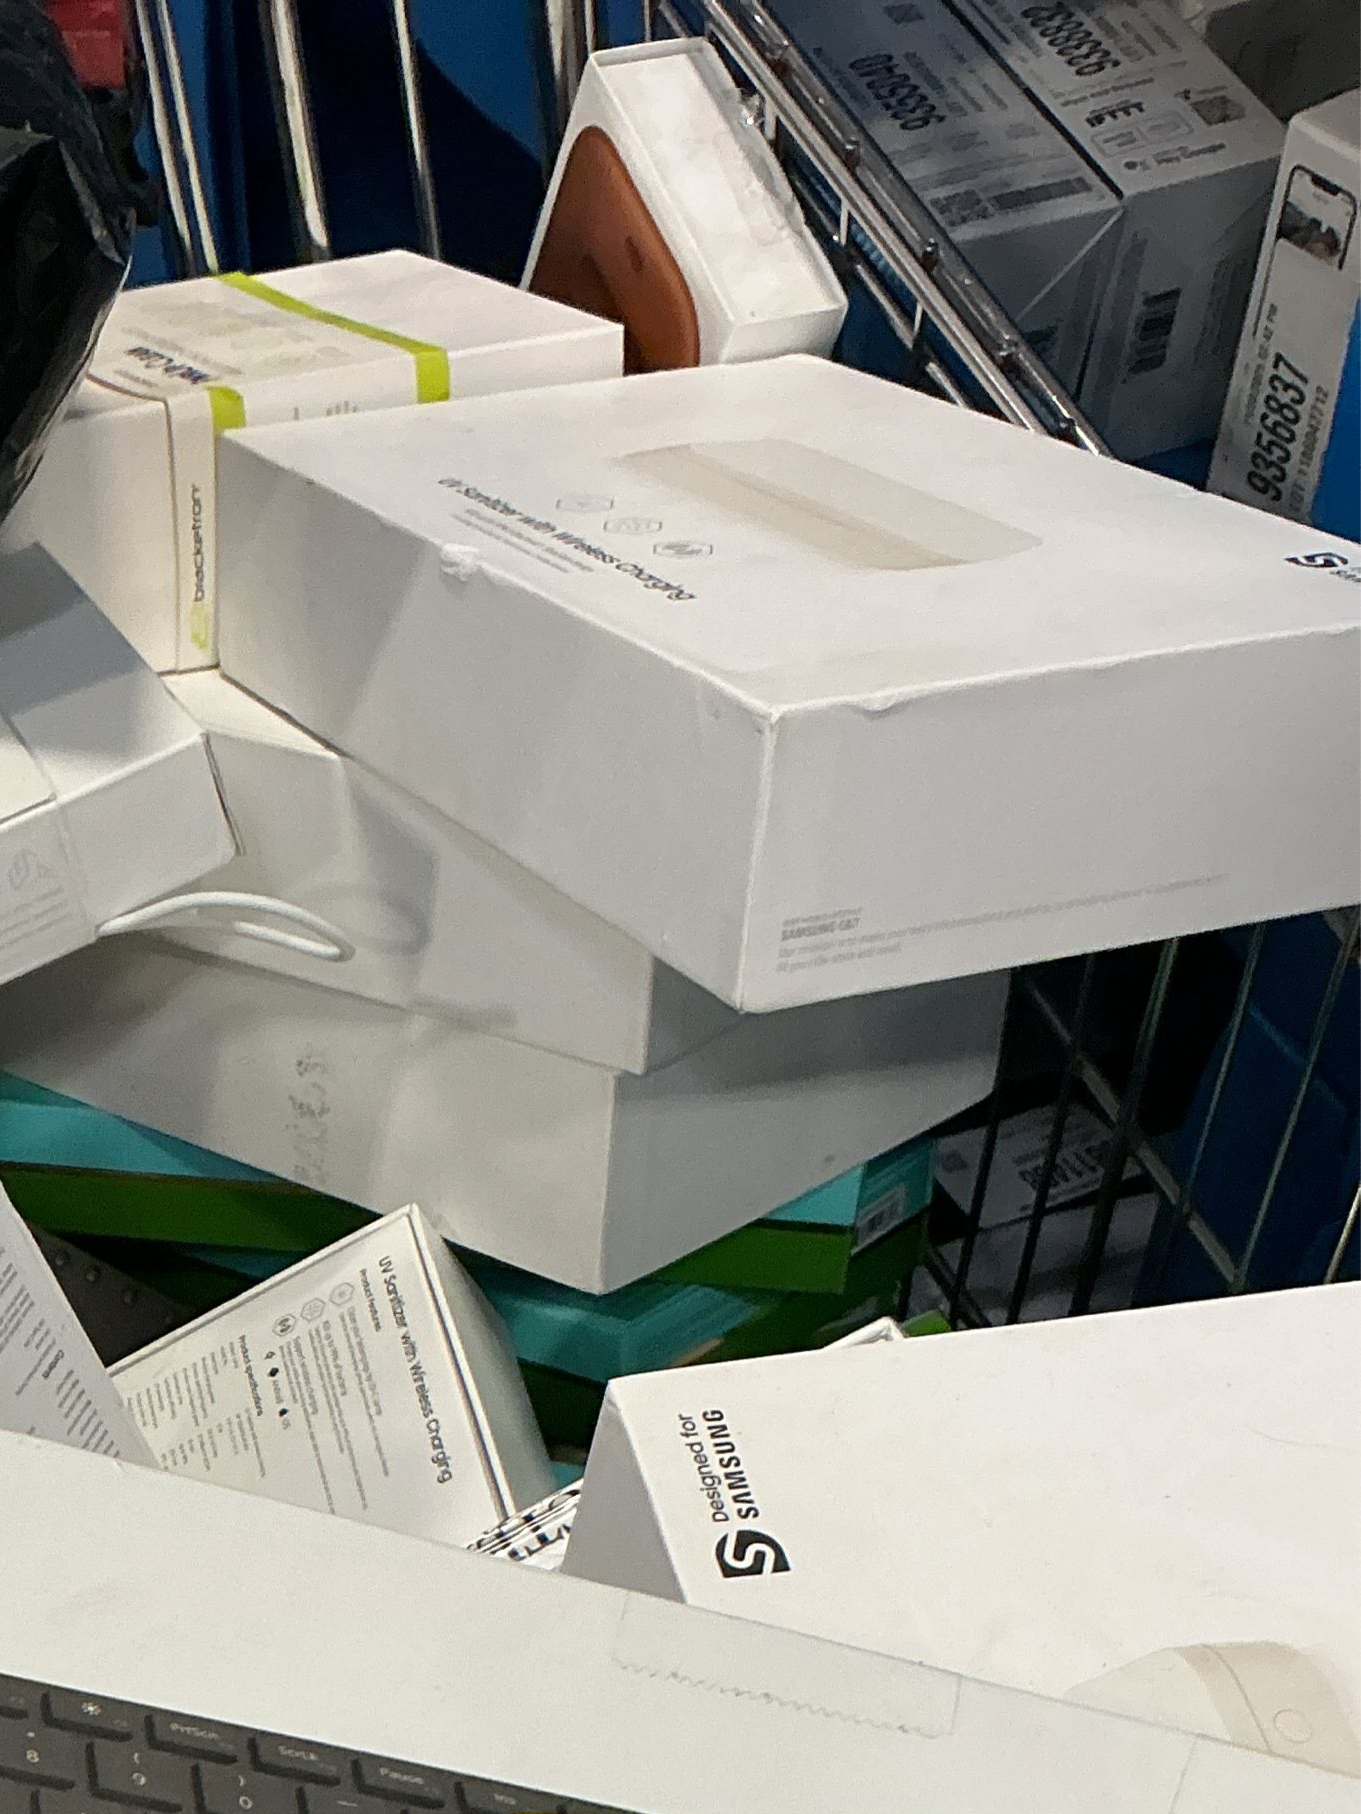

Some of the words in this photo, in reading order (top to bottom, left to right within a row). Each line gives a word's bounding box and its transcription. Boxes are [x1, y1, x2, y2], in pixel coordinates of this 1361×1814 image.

[1246, 353, 1310, 502] 9356837
[191, 482, 207, 602] bracketron
[550, 531, 622, 564] Wireless
[612, 561, 698, 604] Charging
[359, 1268, 374, 1299] Product
[378, 1255, 394, 1274] UV
[383, 1274, 408, 1329] Sanitizer
[238, 1334, 252, 1365] Product
[400, 1330, 417, 1363] with
[244, 1364, 264, 1417] specifications
[409, 1360, 434, 1419] Wireless
[425, 1418, 453, 1485] Charging
[678, 1413, 696, 1436] for
[691, 1438, 728, 1524] Designed
[703, 1409, 759, 1519] SAMSUNG
